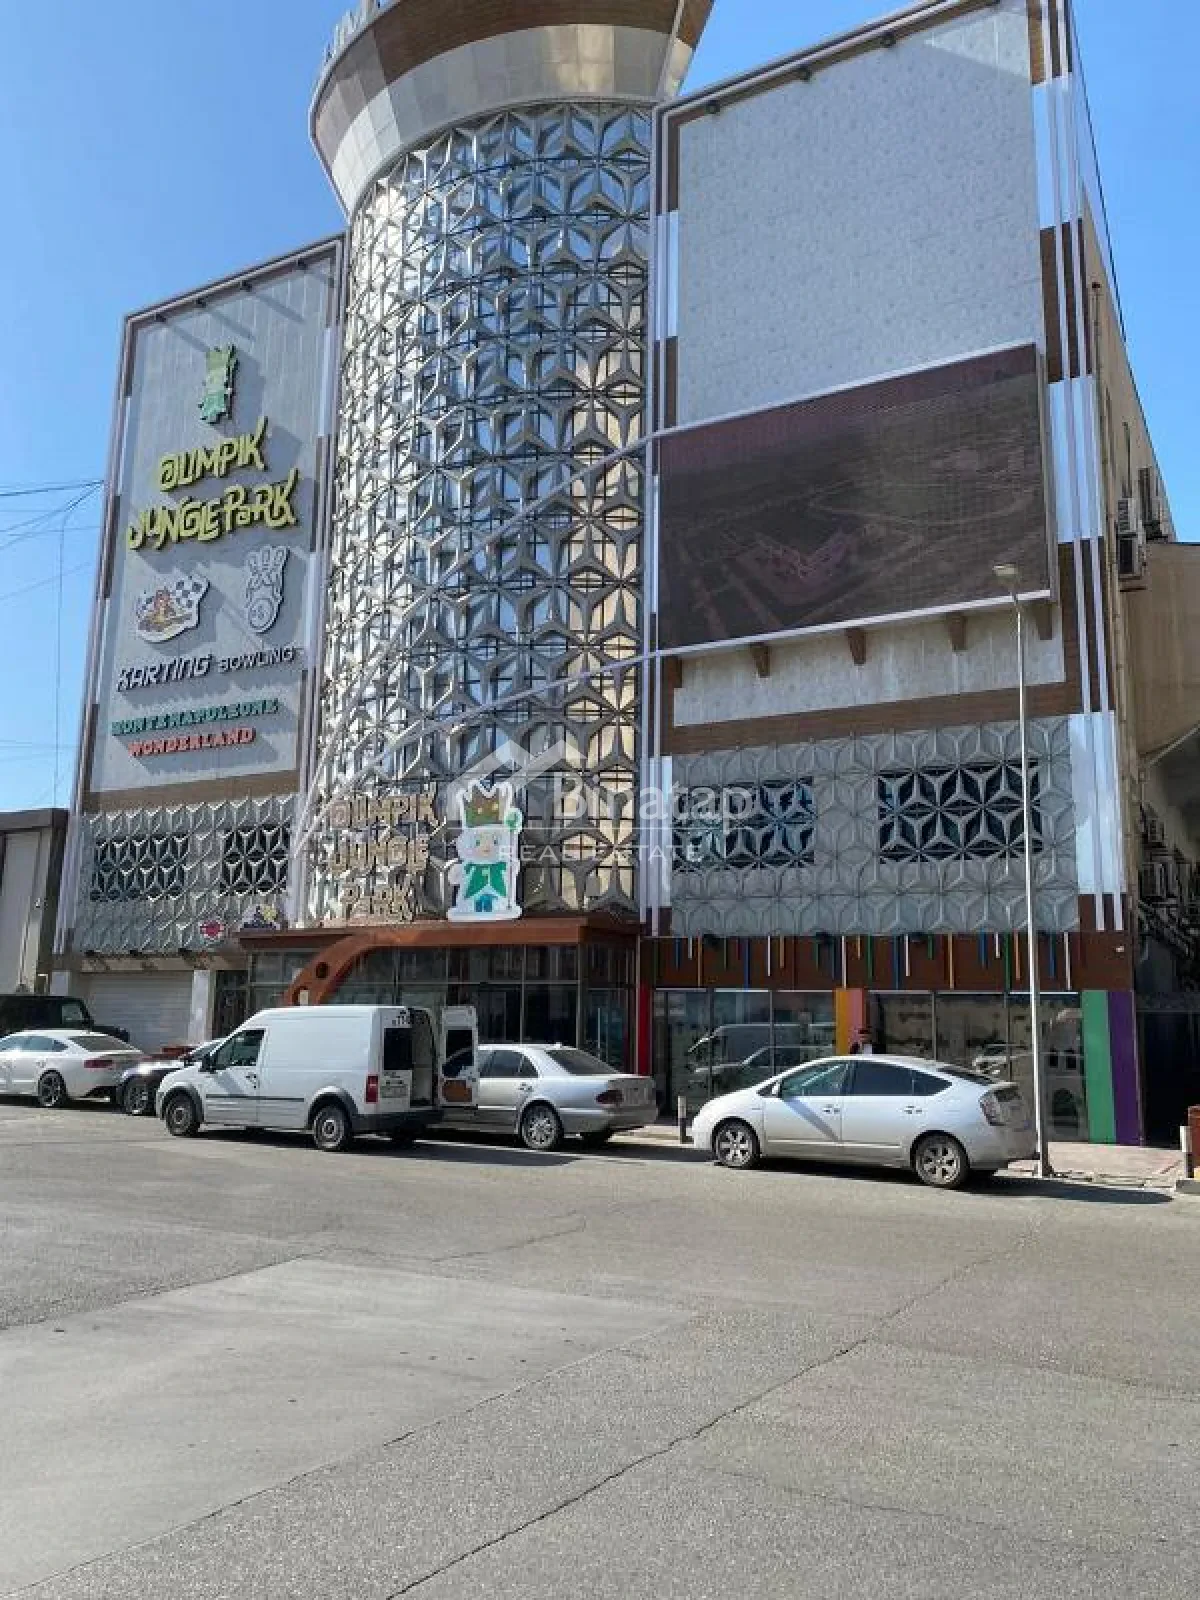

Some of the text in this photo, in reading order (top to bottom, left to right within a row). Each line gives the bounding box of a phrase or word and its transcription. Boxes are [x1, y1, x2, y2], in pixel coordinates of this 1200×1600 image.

[116, 646, 295, 692] KARTING BOWLING
[128, 727, 257, 758] WONDERLAND
[330, 833, 430, 876] JUNGLE
[340, 878, 414, 922] PARK
